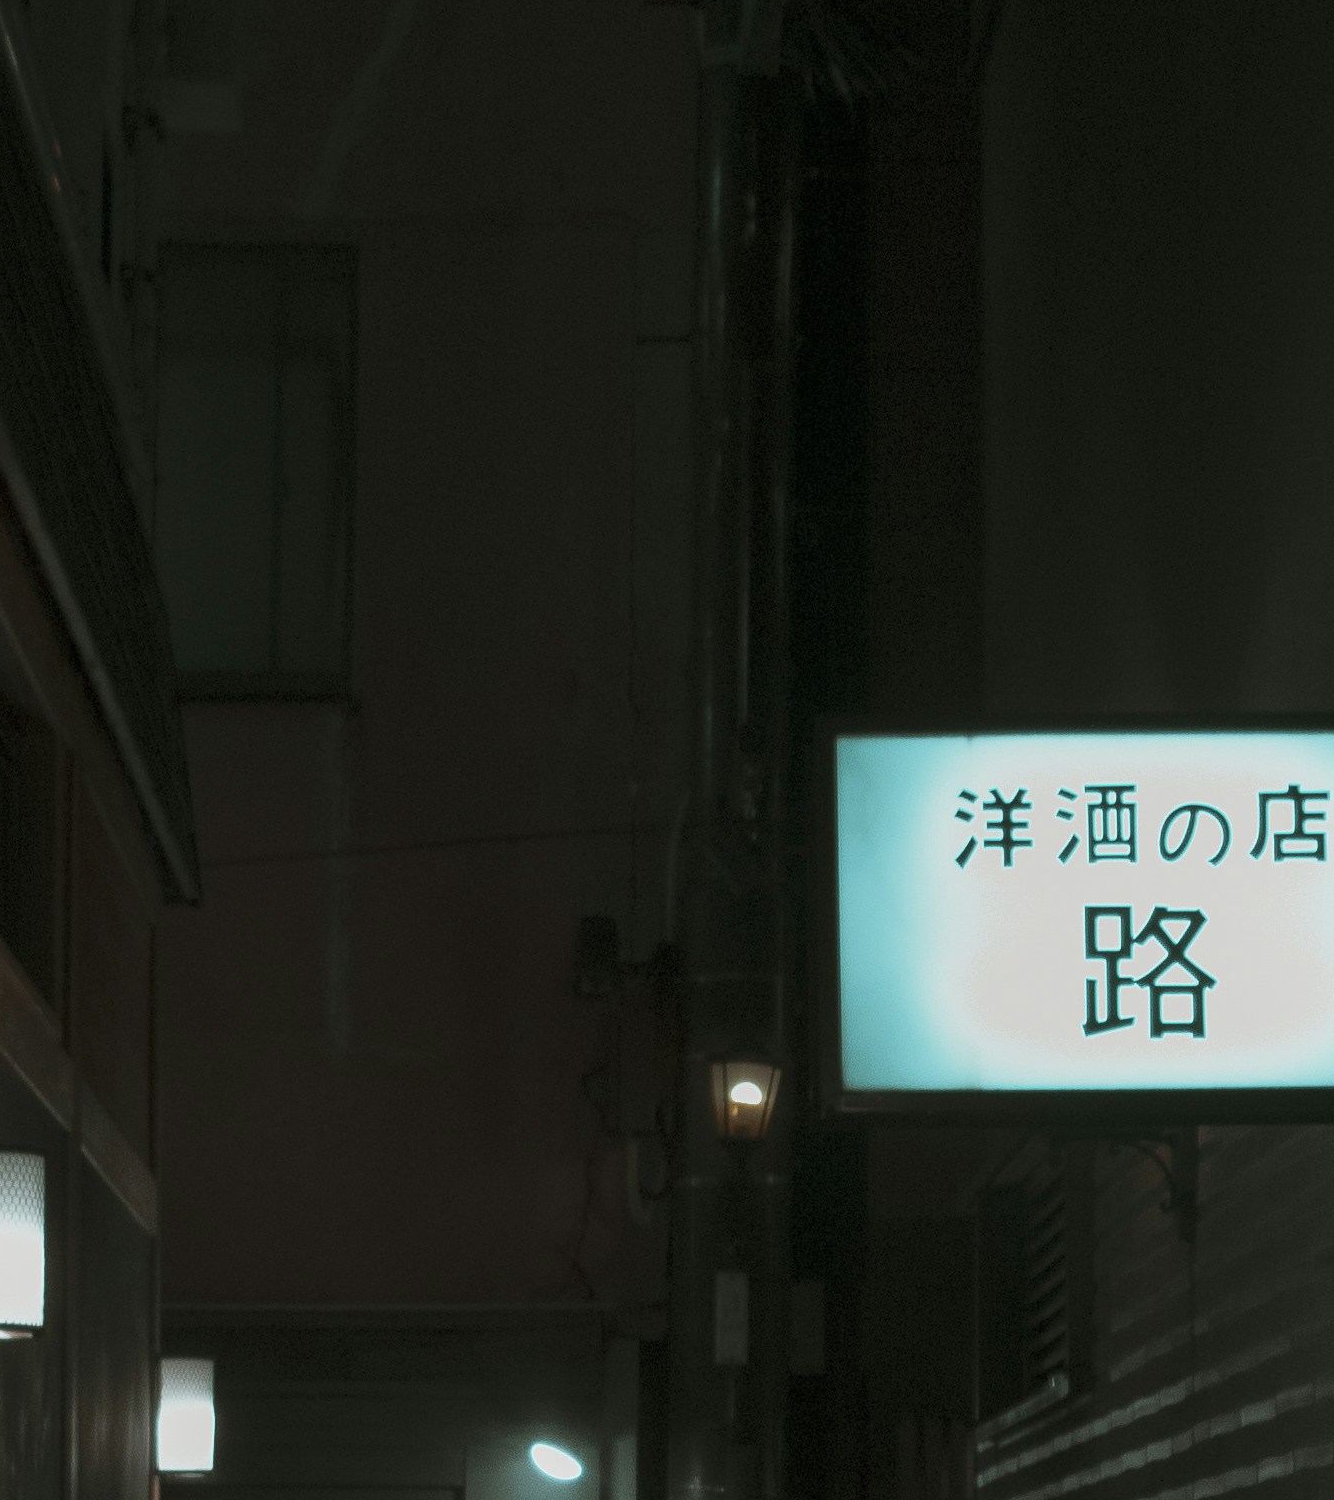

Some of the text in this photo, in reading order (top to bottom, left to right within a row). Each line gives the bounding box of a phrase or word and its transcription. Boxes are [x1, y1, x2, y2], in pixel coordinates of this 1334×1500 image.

[954, 784, 1331, 868] 洋酒の店
[1082, 905, 1217, 1039] 路
